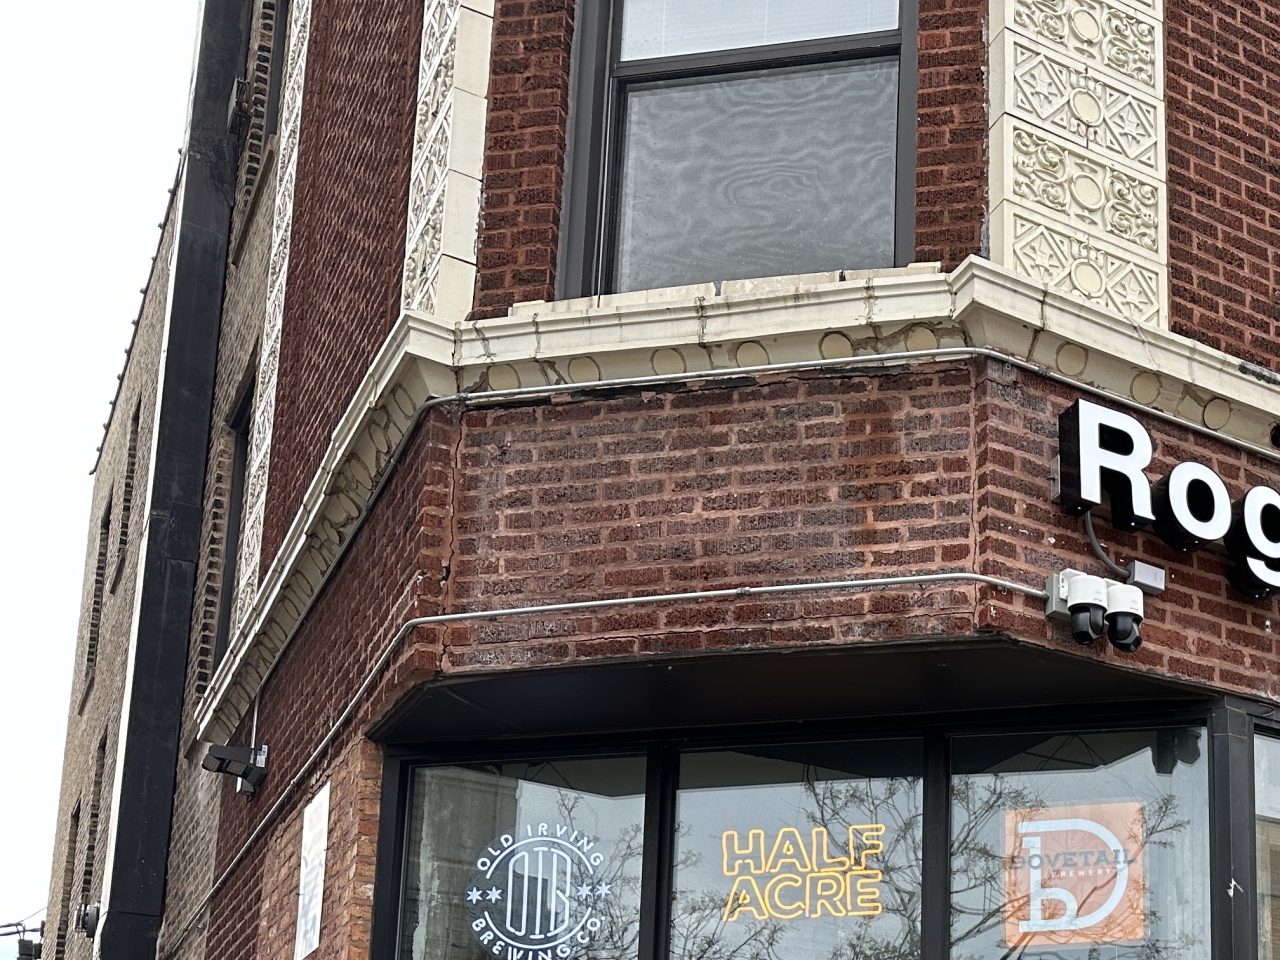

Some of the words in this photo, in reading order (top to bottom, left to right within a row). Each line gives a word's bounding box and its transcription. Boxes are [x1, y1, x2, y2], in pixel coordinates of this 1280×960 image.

[477, 834, 513, 870] OLD
[527, 823, 604, 866] IRVING
[722, 823, 886, 876] HALF
[723, 869, 883, 923] ACRE
